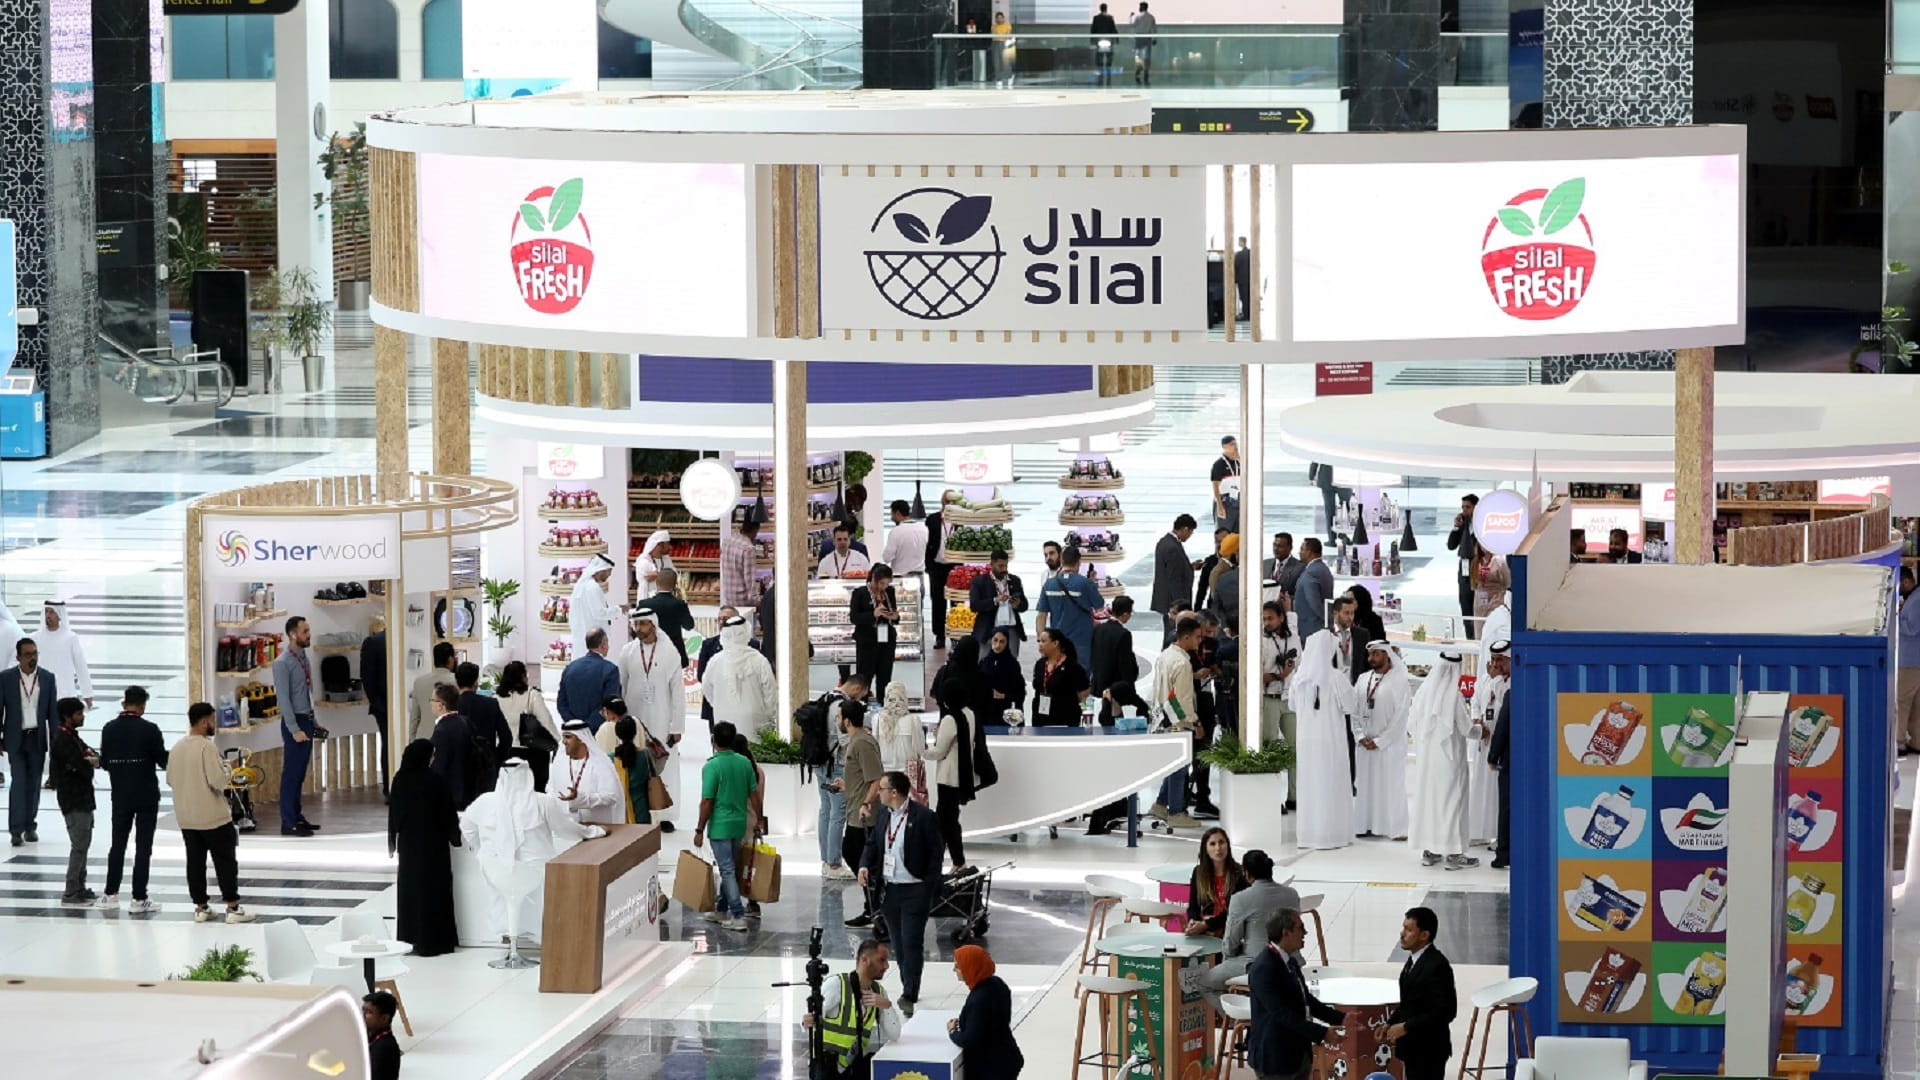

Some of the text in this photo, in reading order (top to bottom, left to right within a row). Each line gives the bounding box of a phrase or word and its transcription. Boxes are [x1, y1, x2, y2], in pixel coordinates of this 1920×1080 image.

[531, 241, 566, 264] silal
[1023, 207, 1162, 256] سلال
[1024, 250, 1162, 305] silal
[1514, 245, 1563, 270] silal
[518, 260, 584, 303] FRESH
[1493, 266, 1585, 308] FRESH
[254, 536, 387, 561] Sherwood
